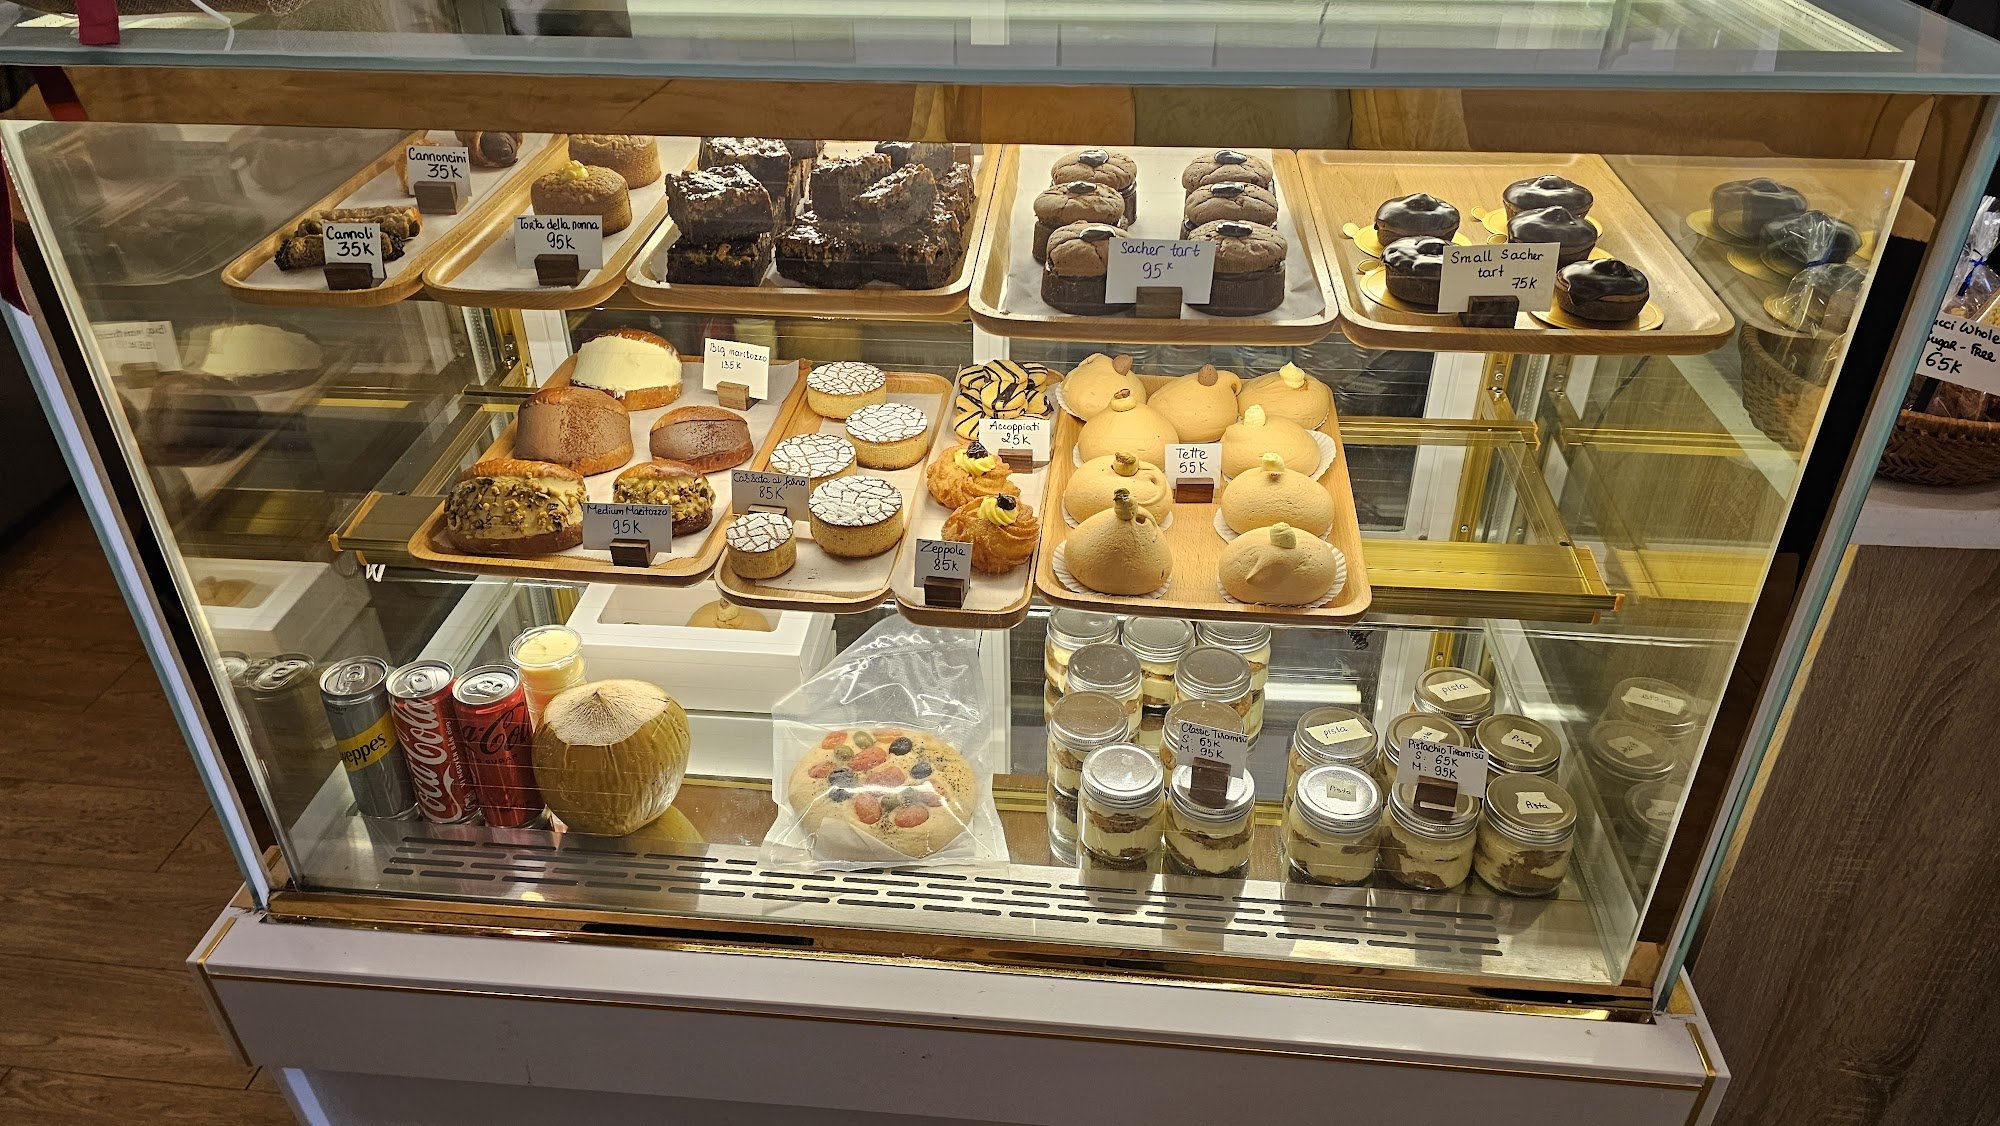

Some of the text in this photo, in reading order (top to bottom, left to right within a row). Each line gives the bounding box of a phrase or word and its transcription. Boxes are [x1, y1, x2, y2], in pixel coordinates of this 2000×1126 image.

[408, 147, 467, 164] Cannoncini
[546, 218, 570, 230] della
[572, 221, 600, 230] nonna
[326, 226, 373, 240] Cannoli
[1120, 241, 1201, 257] Sacher tart
[1450, 248, 1544, 264] Small Sacher
[1478, 264, 1504, 278] tart
[1960, 322, 2000, 344] Whole
[710, 343, 767, 362] Big maritozzo
[989, 420, 1040, 434] Accoppiati
[1175, 447, 1208, 459] Tette
[772, 475, 782, 483] al
[586, 504, 668, 516] Medium Maritozzo
[920, 541, 966, 559] Zeppole
[1181, 722, 1211, 737] Classic
[1408, 738, 1447, 755] Pistachio
